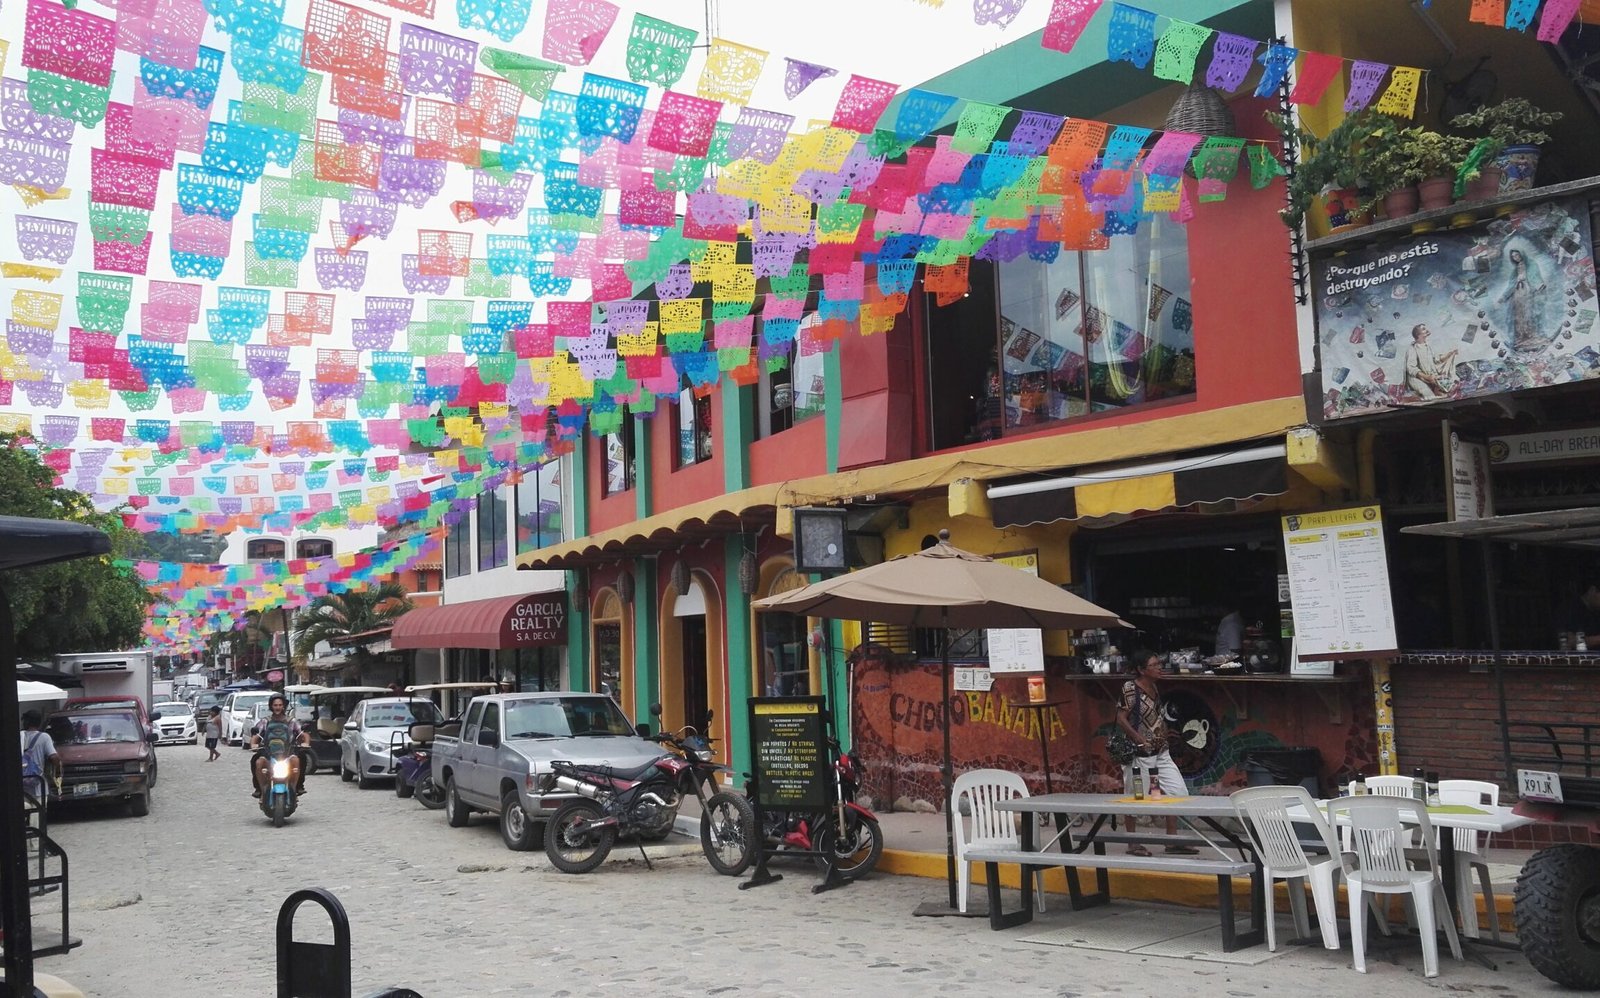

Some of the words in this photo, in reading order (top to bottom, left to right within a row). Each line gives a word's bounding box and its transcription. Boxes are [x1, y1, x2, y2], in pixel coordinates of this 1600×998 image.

[180, 172, 241, 191] SAYULITA
[18, 221, 74, 237] SAYULITA
[1326, 262, 1375, 281] ¿Porque
[1378, 253, 1396, 268] me
[1400, 241, 1439, 260] estás
[1327, 266, 1411, 296] destruyendo?
[1519, 439, 1564, 455] ALL-DAY
[516, 602, 563, 616] GARCIA
[511, 616, 564, 631] REALTY
